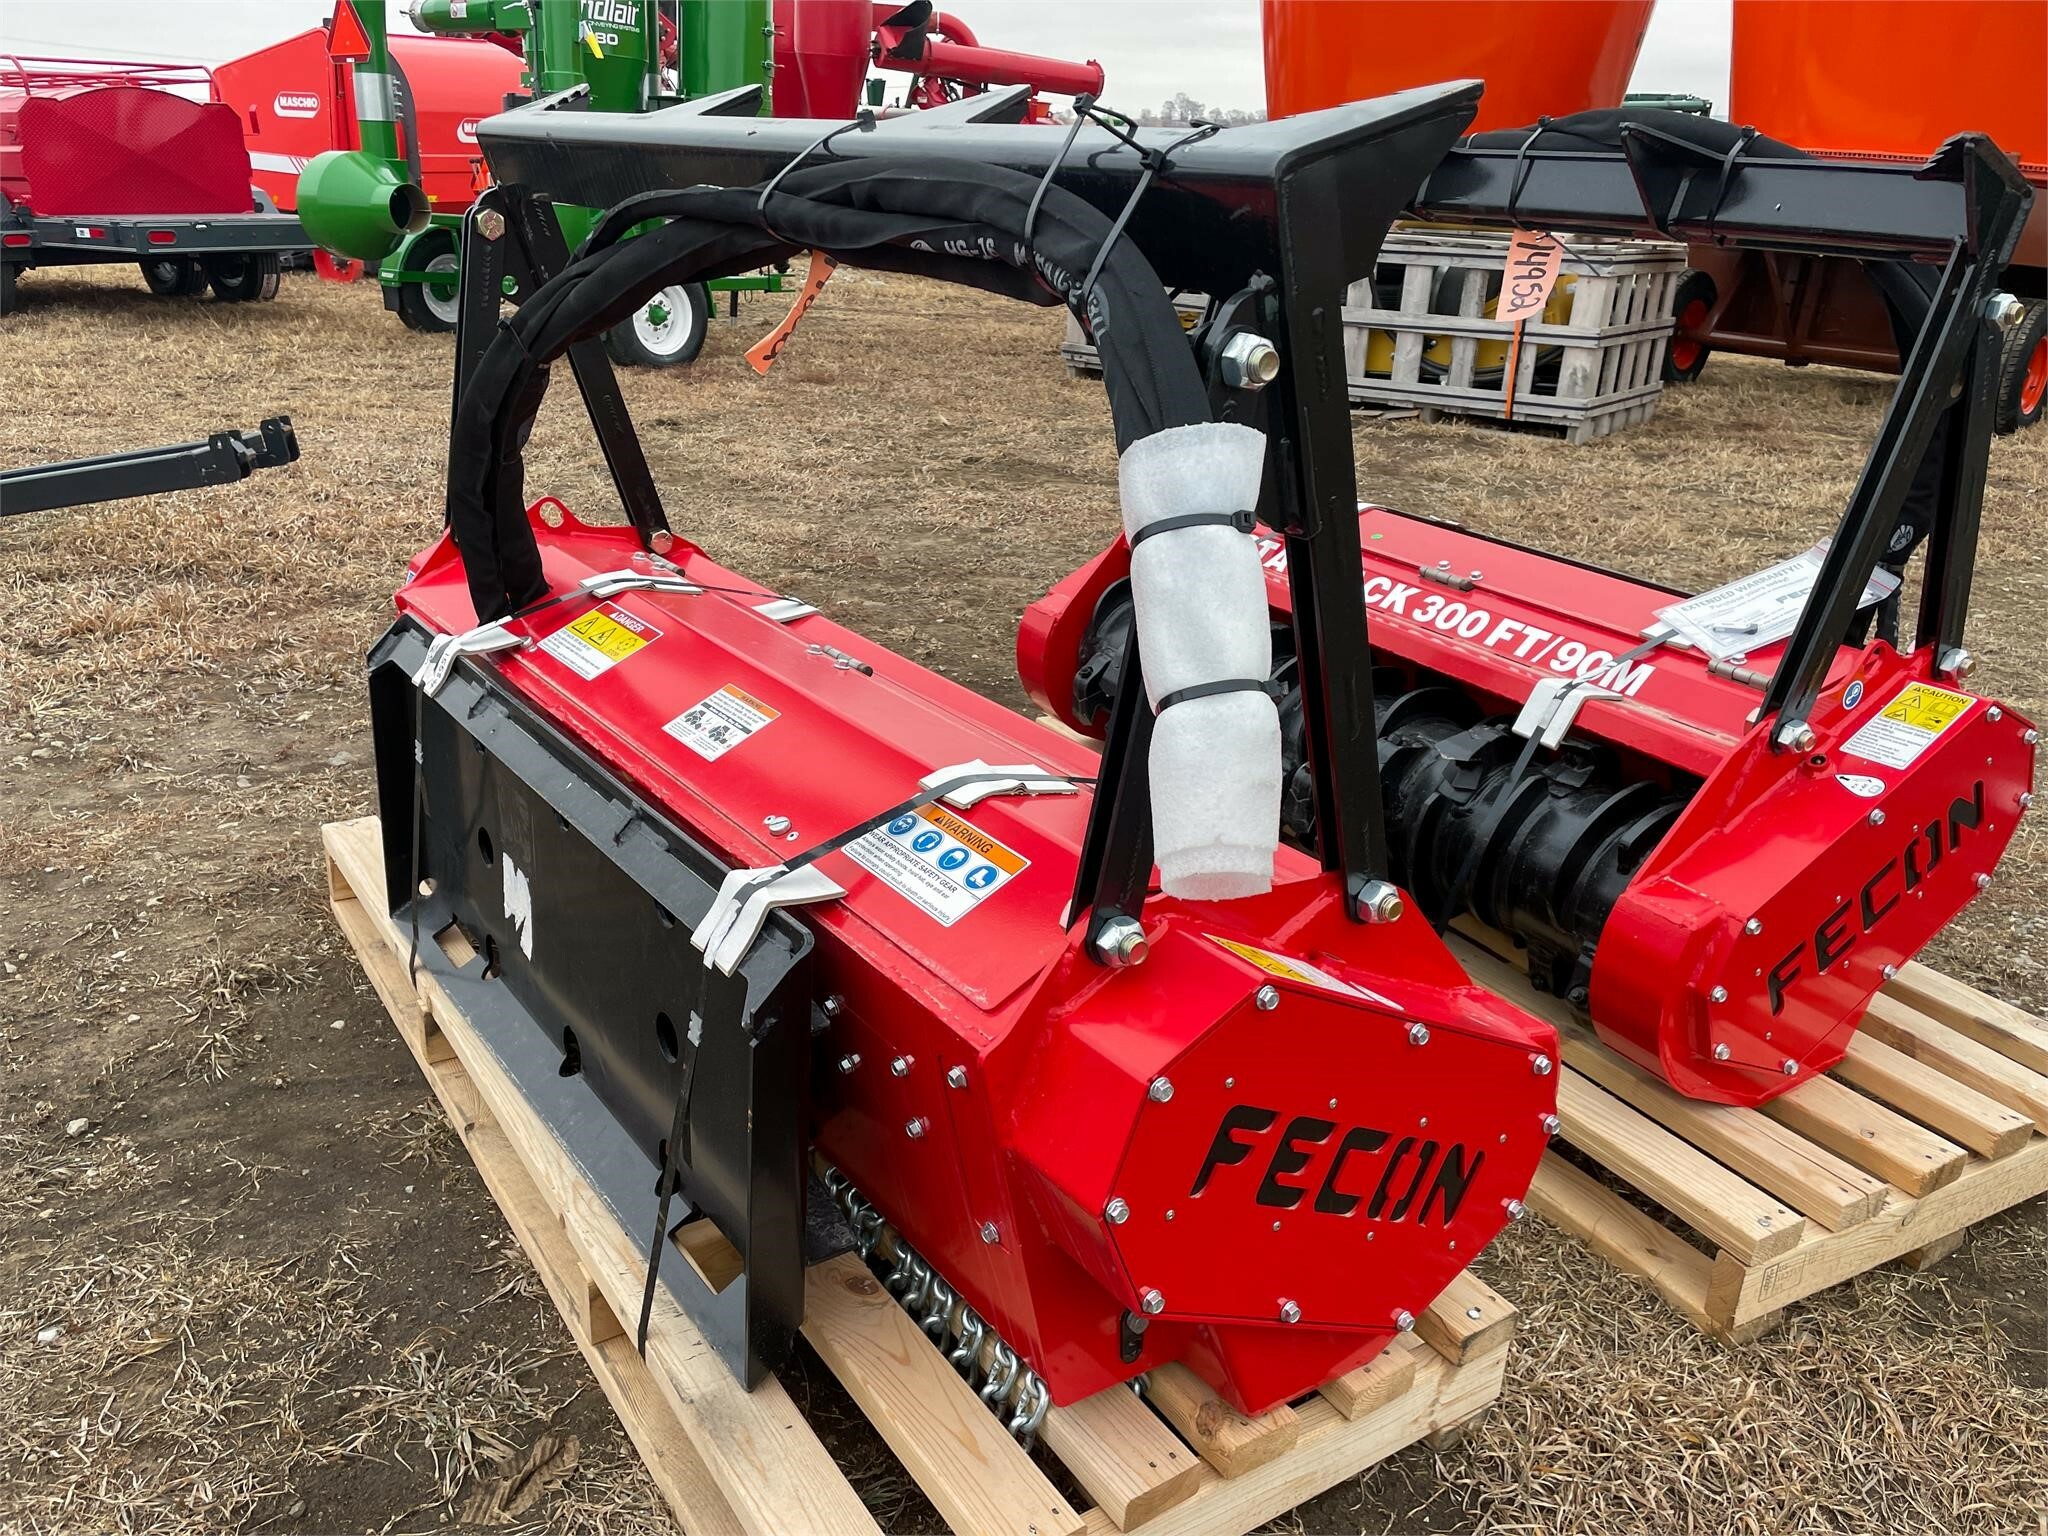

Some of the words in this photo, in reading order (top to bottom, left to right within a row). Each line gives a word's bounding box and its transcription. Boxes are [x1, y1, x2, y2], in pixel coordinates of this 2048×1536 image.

[278, 95, 318, 109] MASCHIO
[1681, 590, 1735, 612] EXTENDED
[615, 611, 646, 634] DANGER
[1412, 594, 1490, 639] 300
[1484, 618, 1656, 697] FT/90M
[1922, 688, 1968, 705] CAUTION
[942, 815, 994, 855] WARNING
[868, 831, 886, 843] WEAR
[882, 841, 921, 867] APPROPRIATE
[917, 865, 941, 881] SAFETY
[938, 879, 958, 893] GEAR
[1768, 779, 1984, 1017] FECON
[1188, 1104, 1487, 1229] FECON
